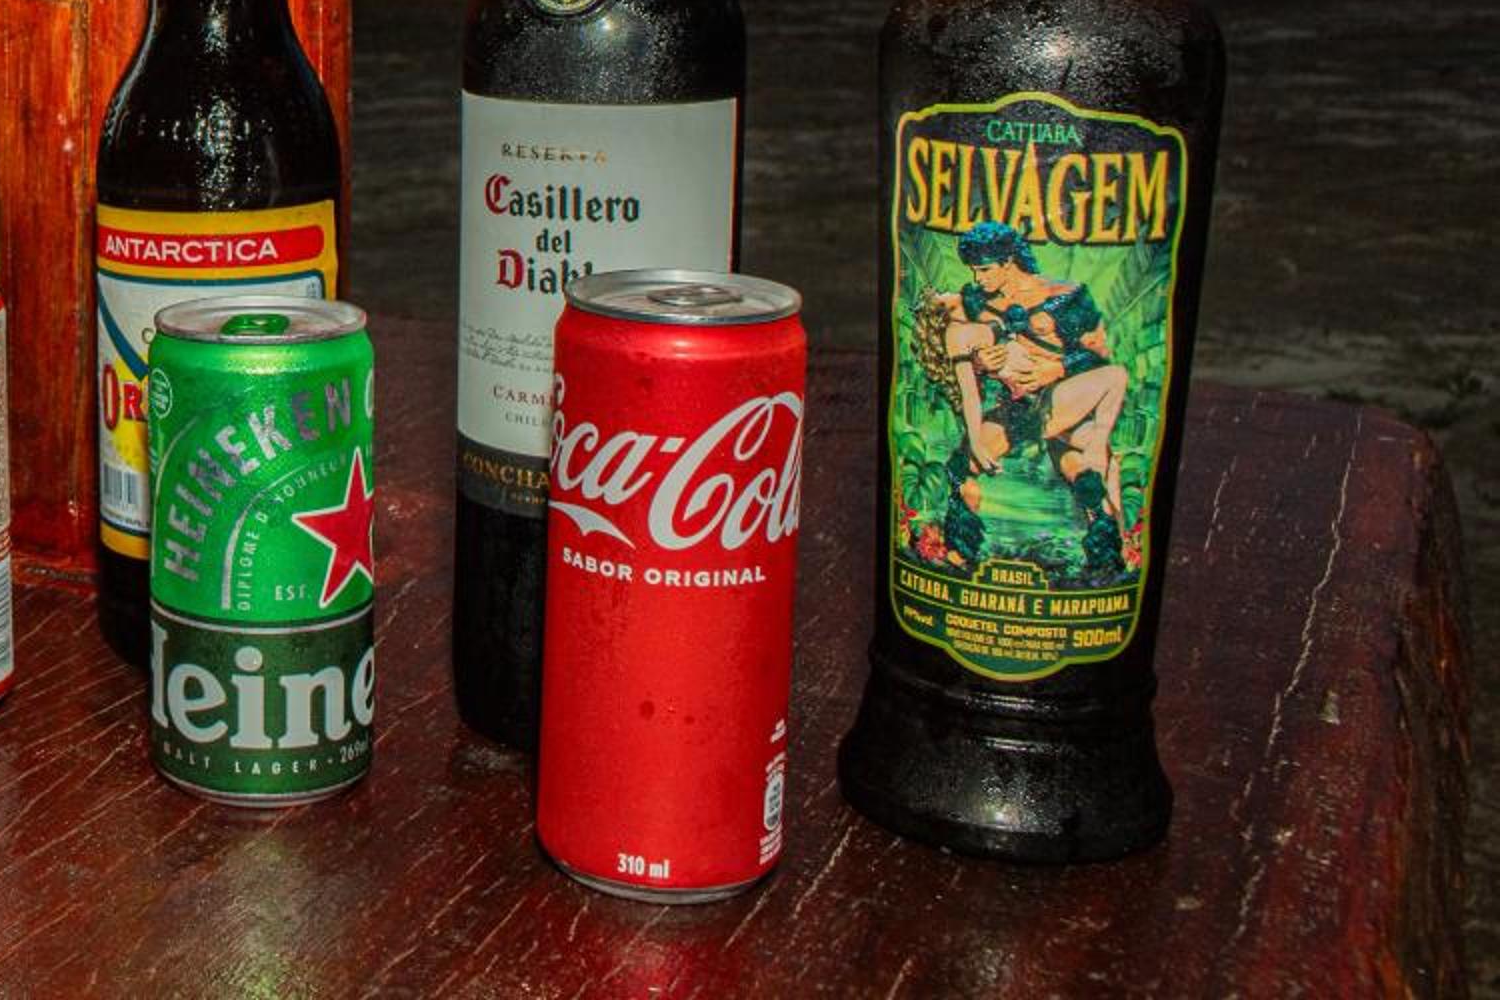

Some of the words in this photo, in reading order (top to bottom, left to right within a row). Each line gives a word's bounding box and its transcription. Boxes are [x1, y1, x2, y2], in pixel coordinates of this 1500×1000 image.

[986, 119, 1084, 147] CATUABA
[485, 173, 640, 223] Casillero
[907, 137, 1169, 243] SELVAGEM
[105, 234, 279, 263] ANTARCTICA
[536, 228, 572, 253] del
[549, 373, 803, 550] oca-Col
[164, 377, 351, 582] HEINEKEN
[563, 547, 633, 581] SABOR
[644, 566, 766, 588] ORIGINAL
[991, 568, 1035, 586] BRASIL
[1033, 599, 1043, 616] E
[1073, 625, 1123, 648] 900ml
[234, 757, 319, 776] LAGER
[617, 852, 645, 876] 310
[649, 859, 670, 879] ml
